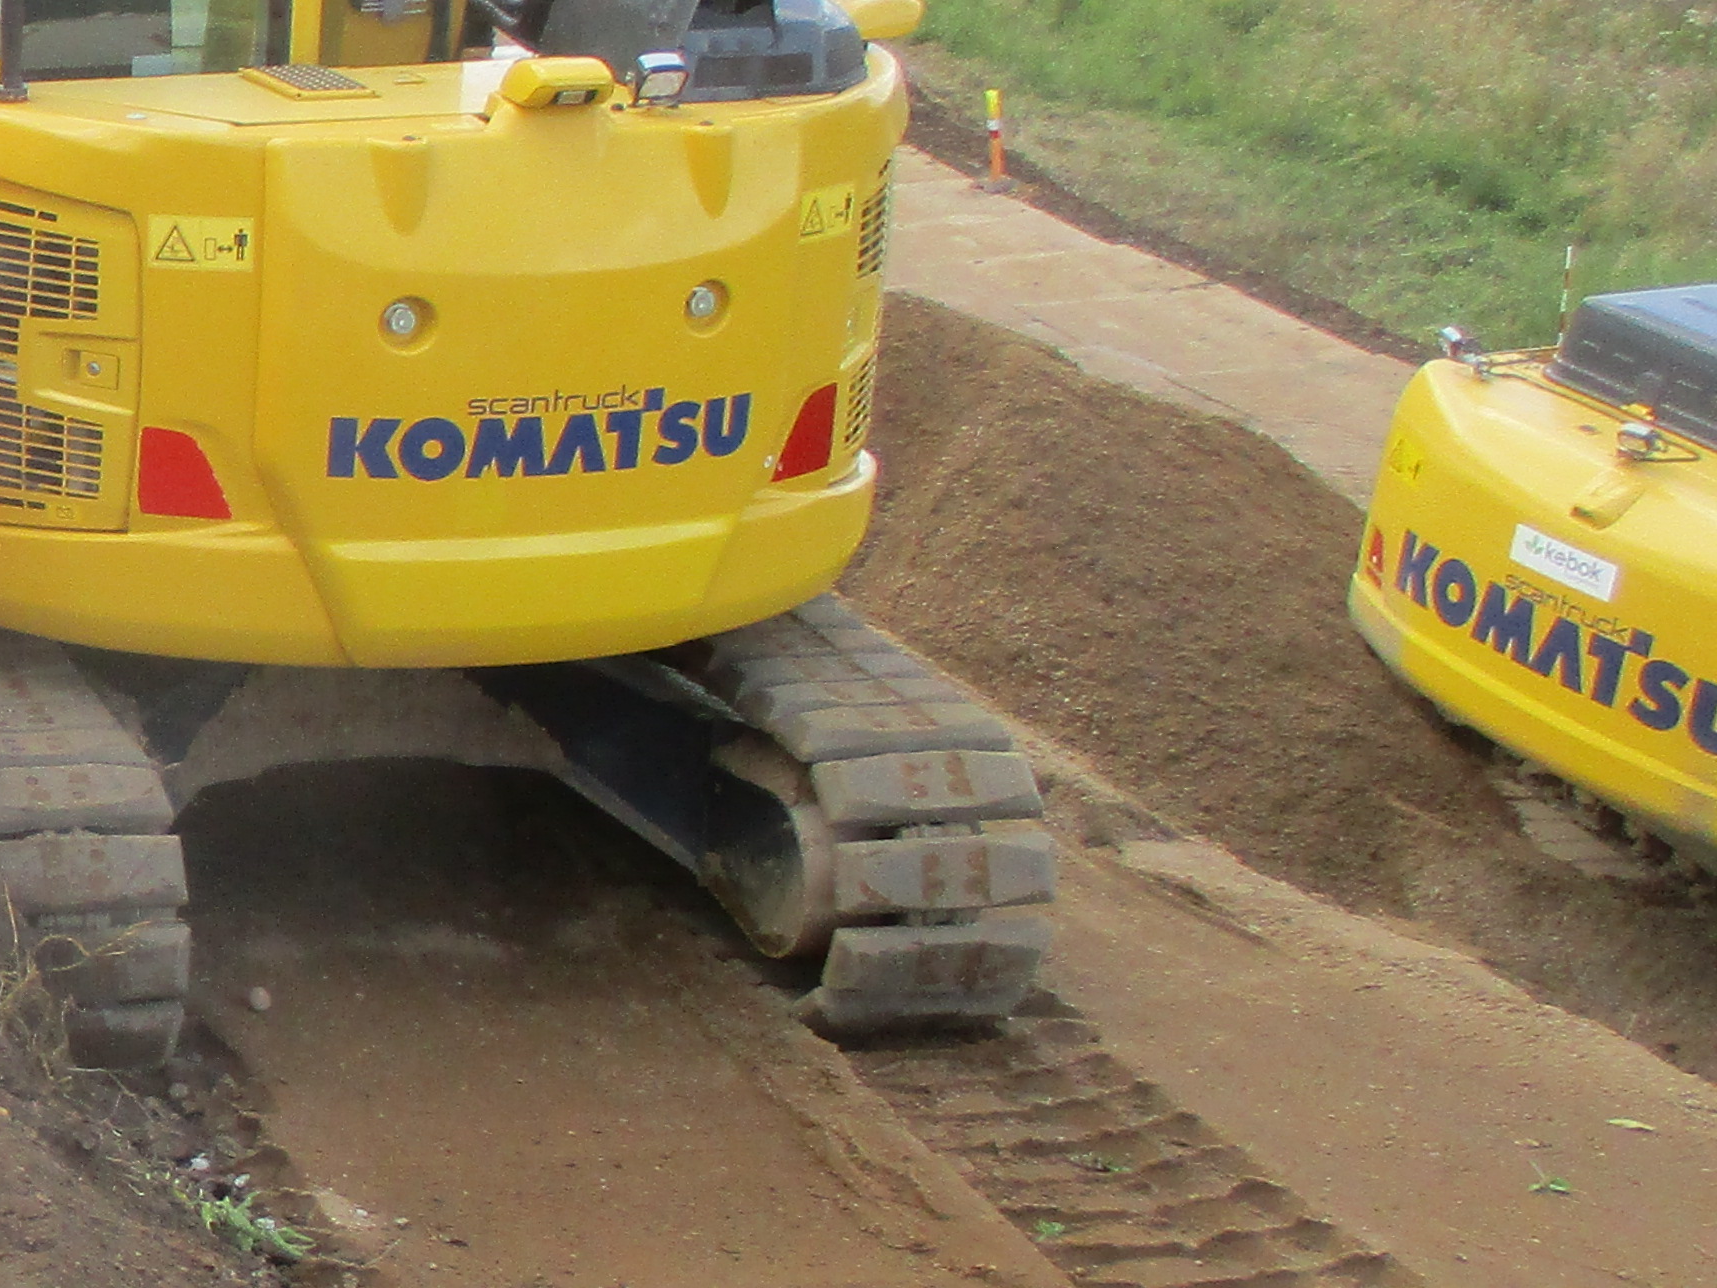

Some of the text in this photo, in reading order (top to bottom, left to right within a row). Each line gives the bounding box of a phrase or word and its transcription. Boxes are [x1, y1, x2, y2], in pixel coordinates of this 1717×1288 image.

[326, 387, 753, 482] KOMATSU
[467, 385, 641, 416] scantruck
[1505, 574, 1631, 644] scantruck
